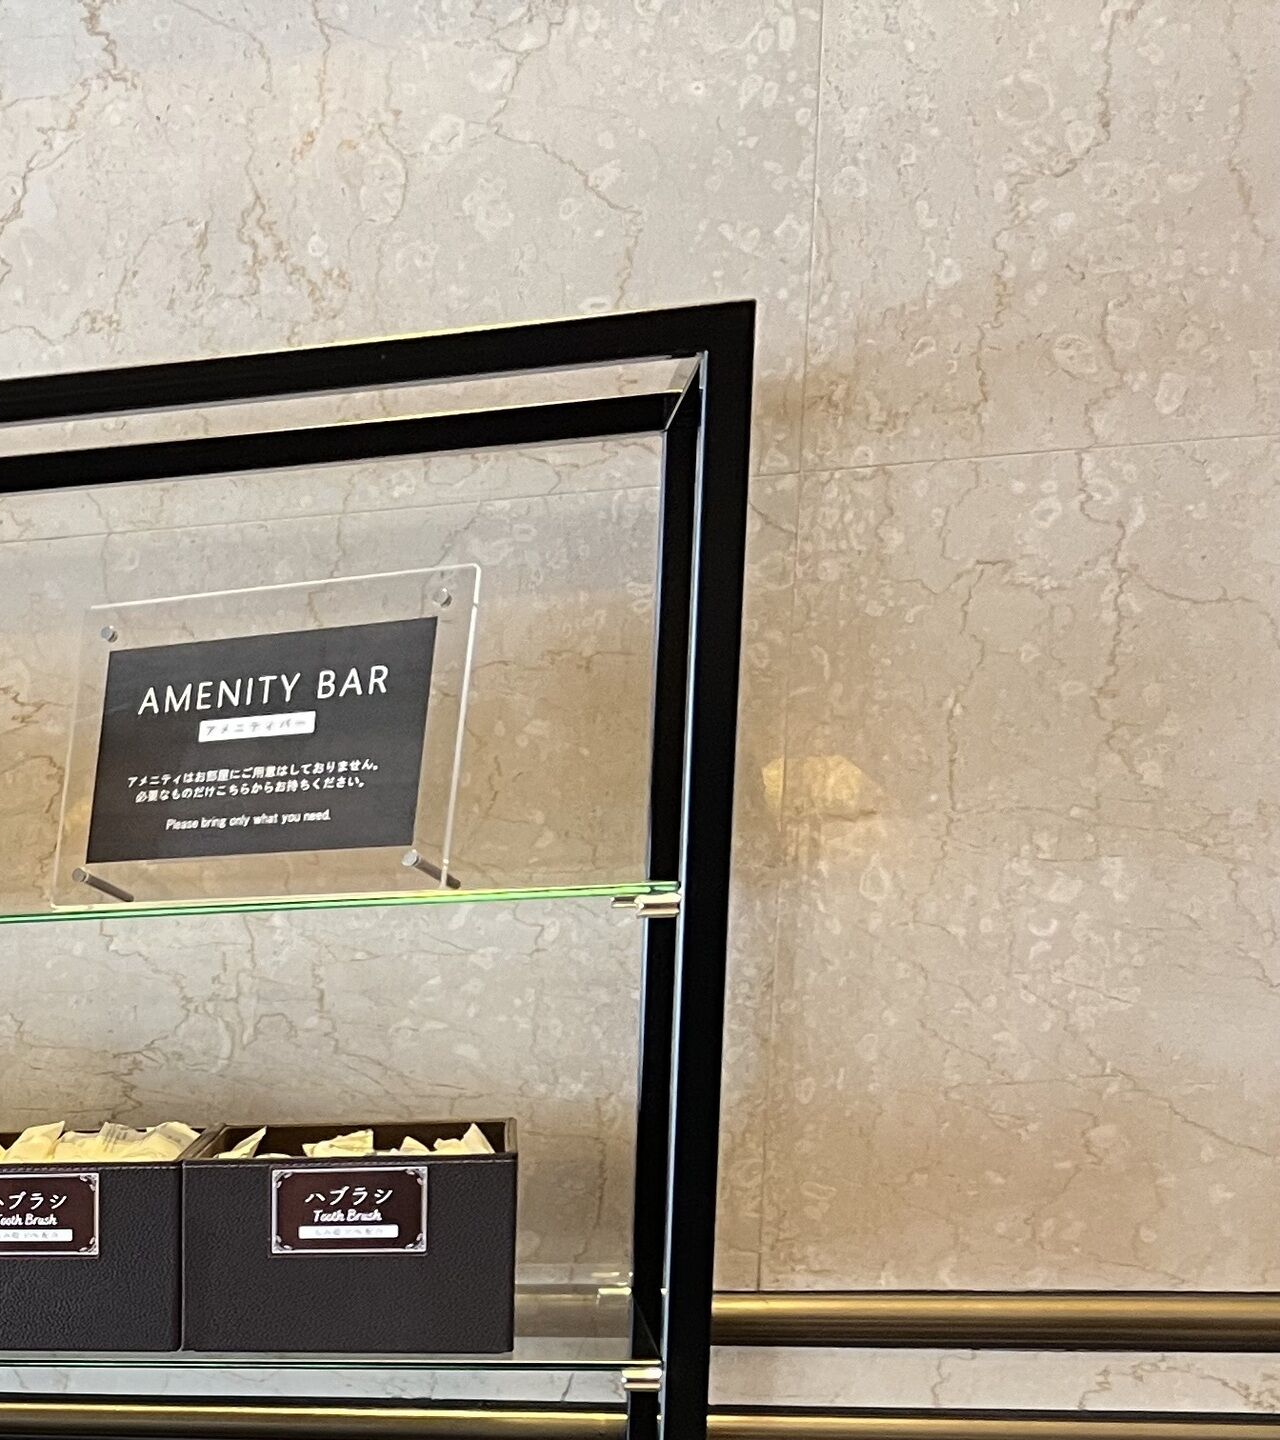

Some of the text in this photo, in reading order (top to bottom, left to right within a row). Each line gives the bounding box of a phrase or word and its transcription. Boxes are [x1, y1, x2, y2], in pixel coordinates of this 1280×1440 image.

[137, 664, 390, 716] AMENITY BAR
[206, 718, 308, 737] アメニティバー
[165, 818, 199, 831] Please
[200, 816, 227, 829] bring
[229, 813, 251, 827] only
[253, 813, 279, 825] what
[281, 812, 302, 825] you
[304, 1185, 394, 1206] ハブラシ
[24, 1212, 58, 1226] Brush
[313, 1208, 383, 1223] Tooth Brush
